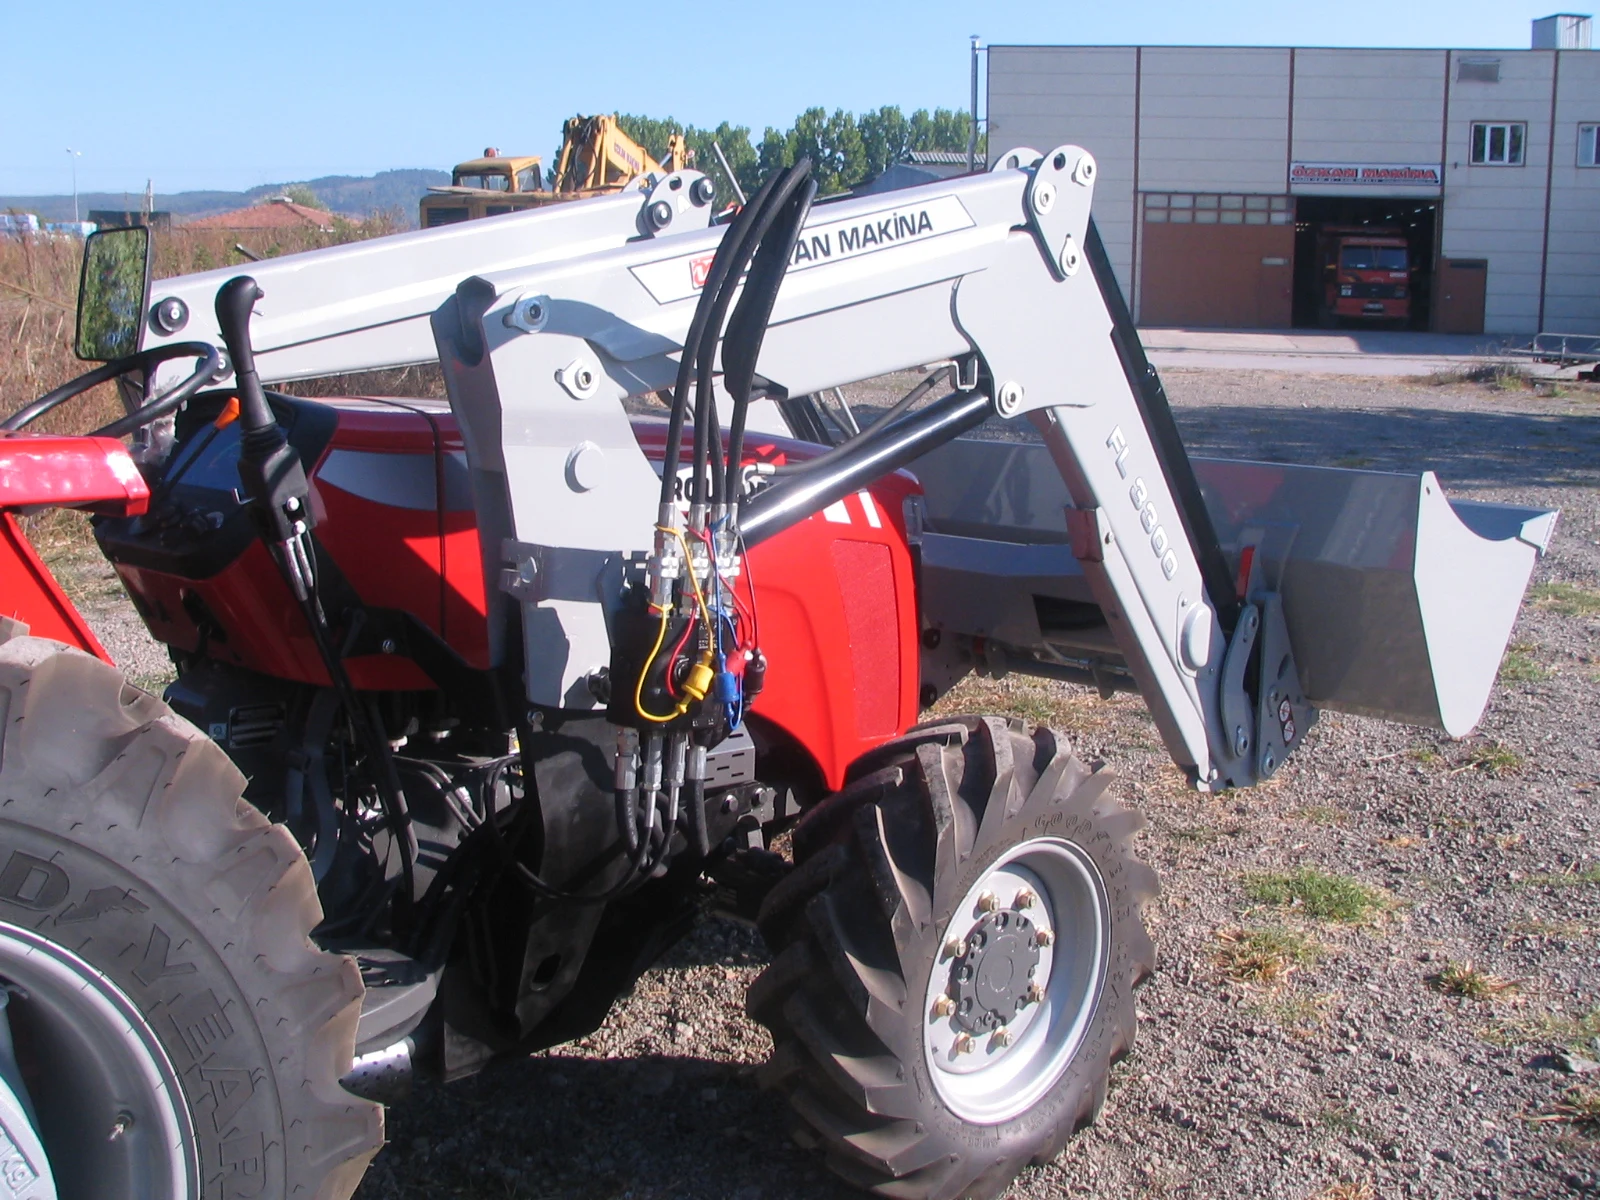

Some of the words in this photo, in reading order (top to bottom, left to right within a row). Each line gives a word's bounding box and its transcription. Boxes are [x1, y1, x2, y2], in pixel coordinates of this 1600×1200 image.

[839, 210, 933, 253] MAKİNA
[1106, 424, 1129, 480] FL
[1129, 477, 1178, 581] 3300
